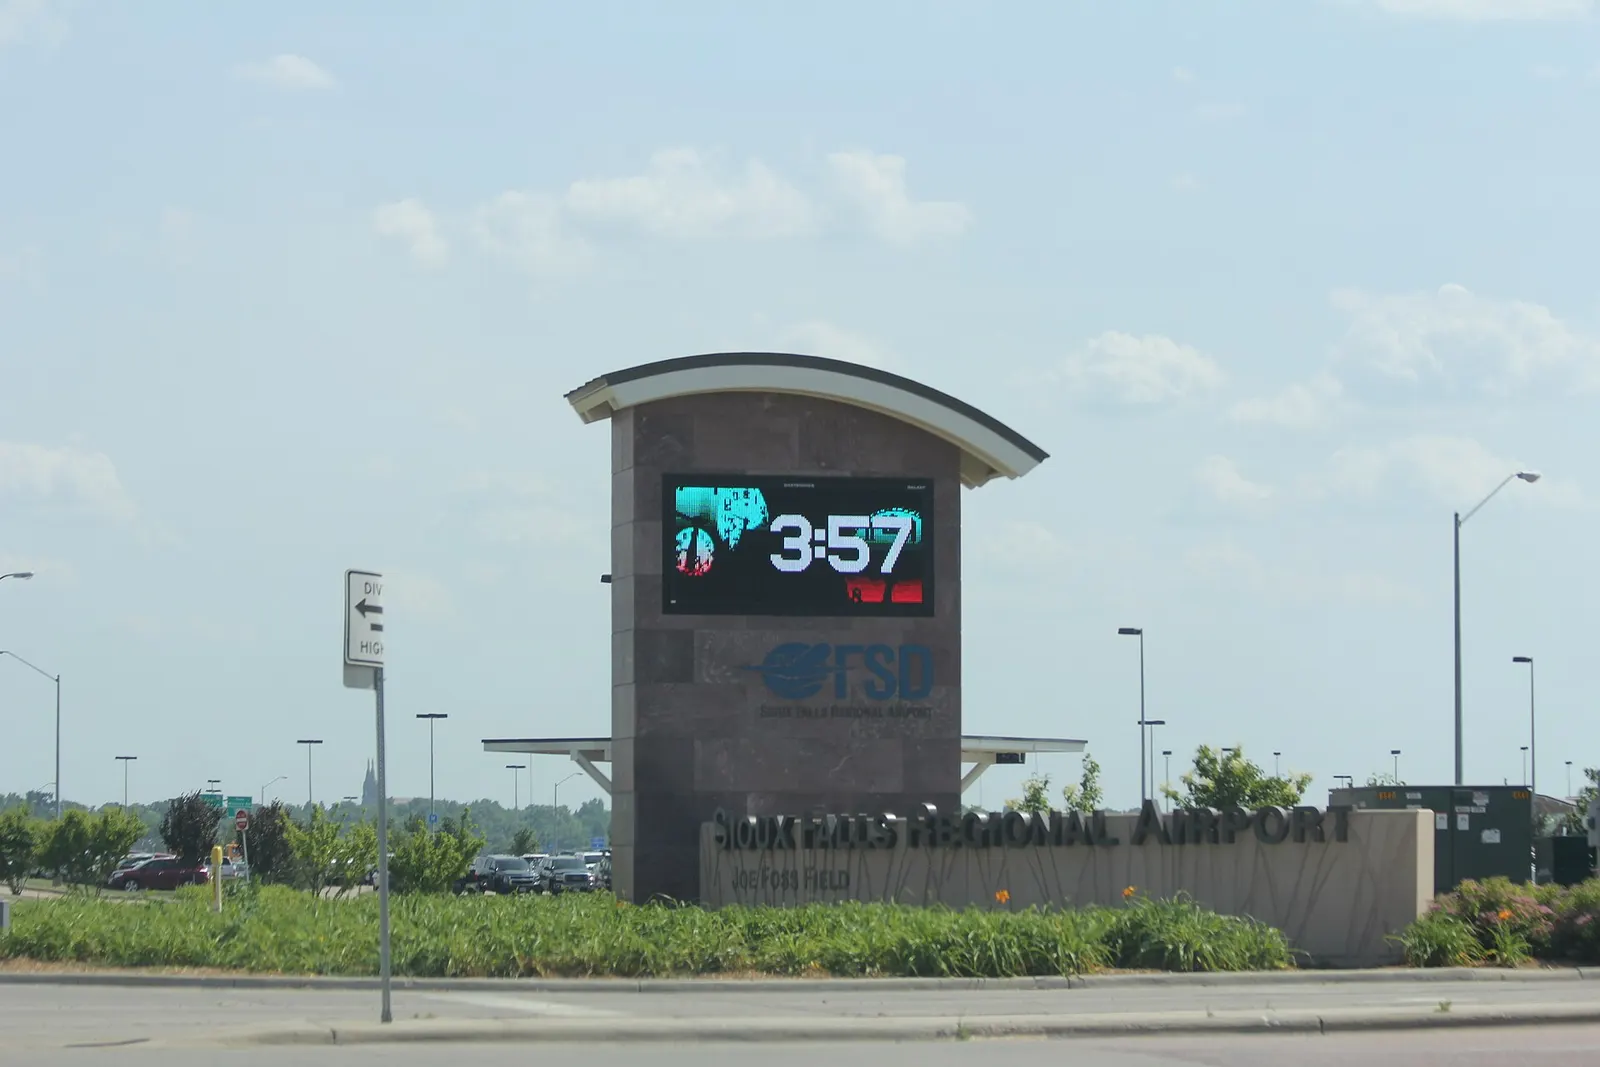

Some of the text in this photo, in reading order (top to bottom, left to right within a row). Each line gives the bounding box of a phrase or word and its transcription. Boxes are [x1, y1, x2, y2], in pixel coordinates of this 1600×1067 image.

[770, 514, 912, 574] 3:57
[834, 643, 934, 700] FSD
[713, 799, 1354, 850] SIOUX FALLS REGIONAL AIRPORT
[732, 865, 850, 890] JOE FOSS FIELD
